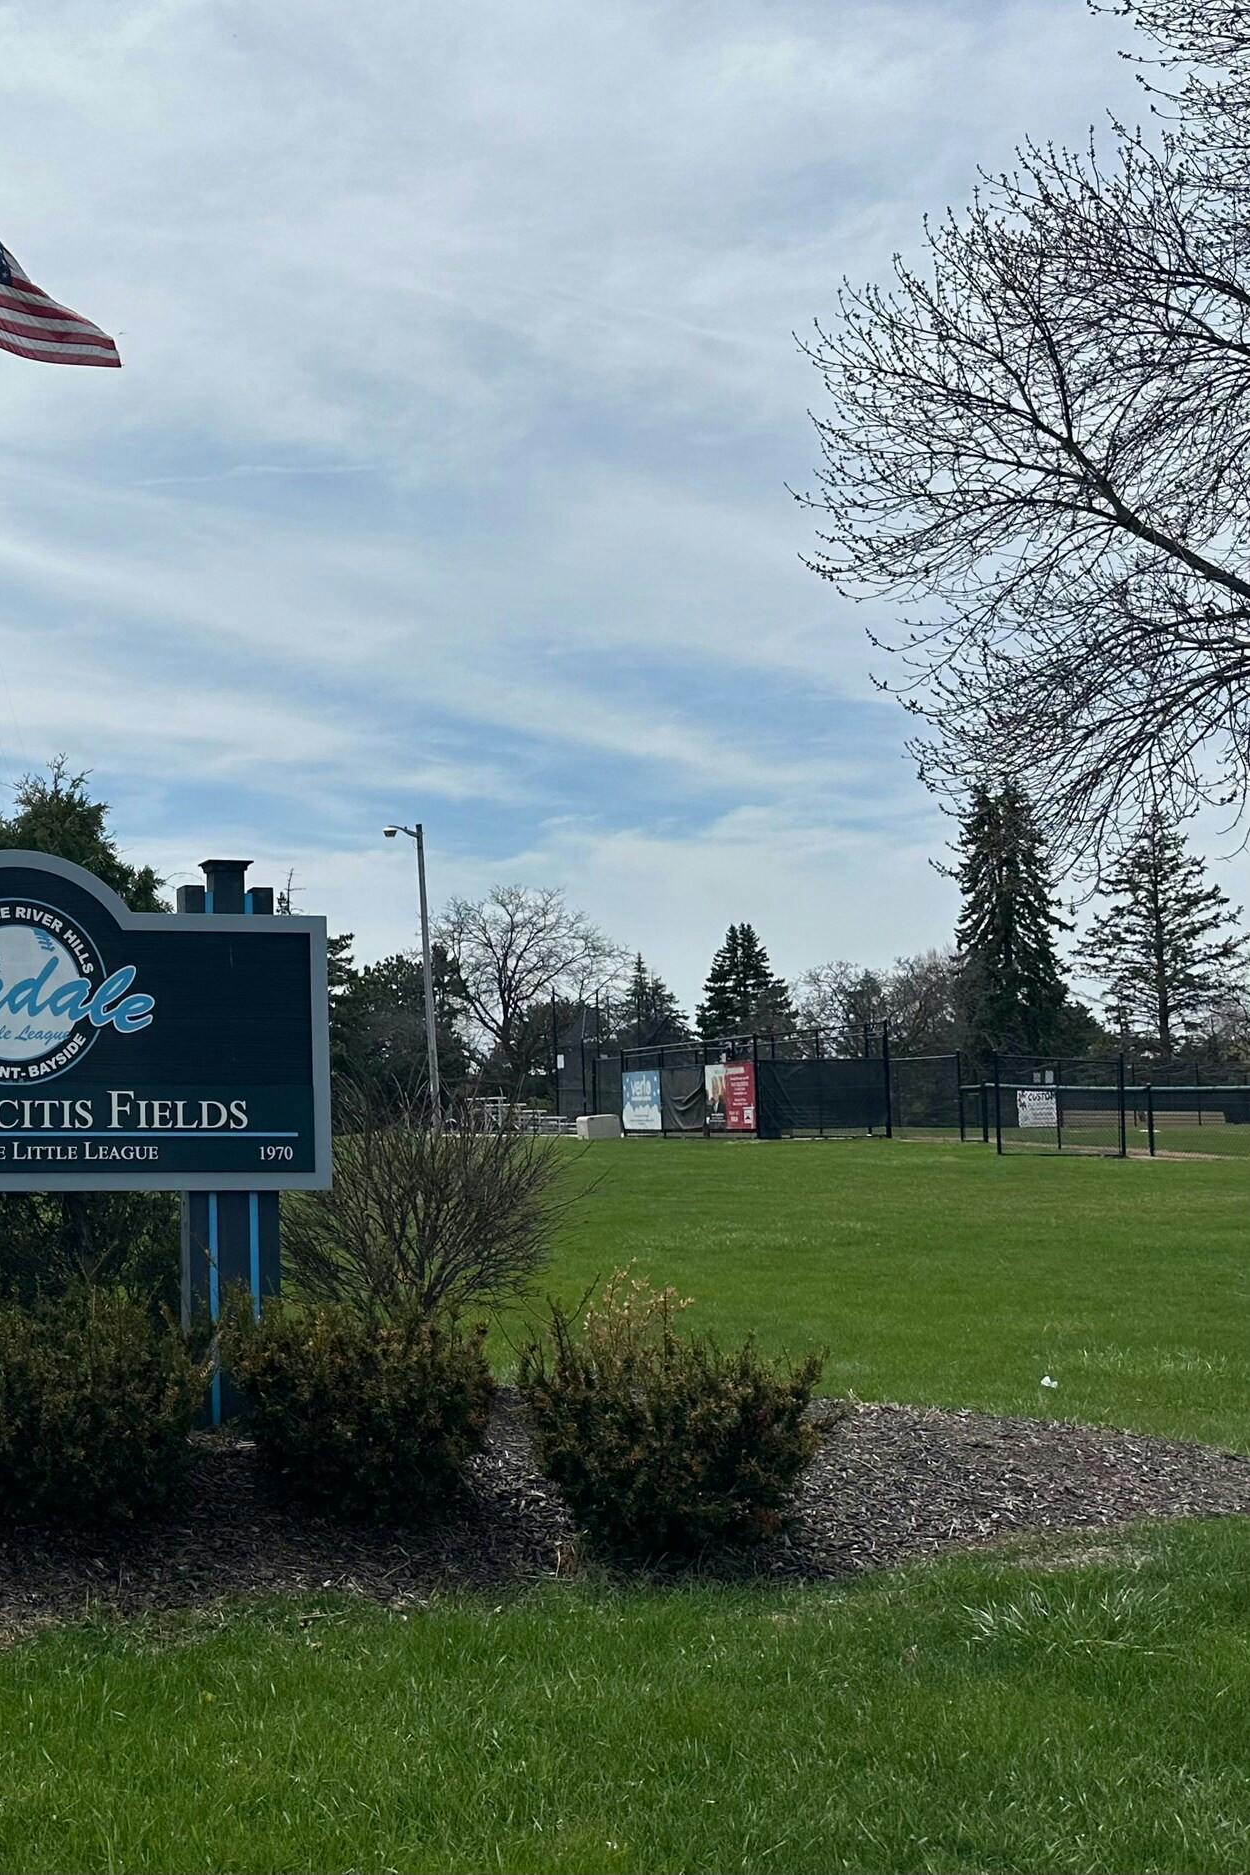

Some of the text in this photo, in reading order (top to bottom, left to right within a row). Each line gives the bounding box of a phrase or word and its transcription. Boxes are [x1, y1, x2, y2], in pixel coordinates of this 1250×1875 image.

[15, 906, 64, 932] RIVER
[62, 929, 94, 975] HILLS
[15, 1024, 71, 1047] League
[106, 1089, 249, 1130] FIELDS
[11, 1141, 79, 1162] LITTLE
[83, 1141, 160, 1162] LEAGUE
[258, 1145, 294, 1162] 1970
